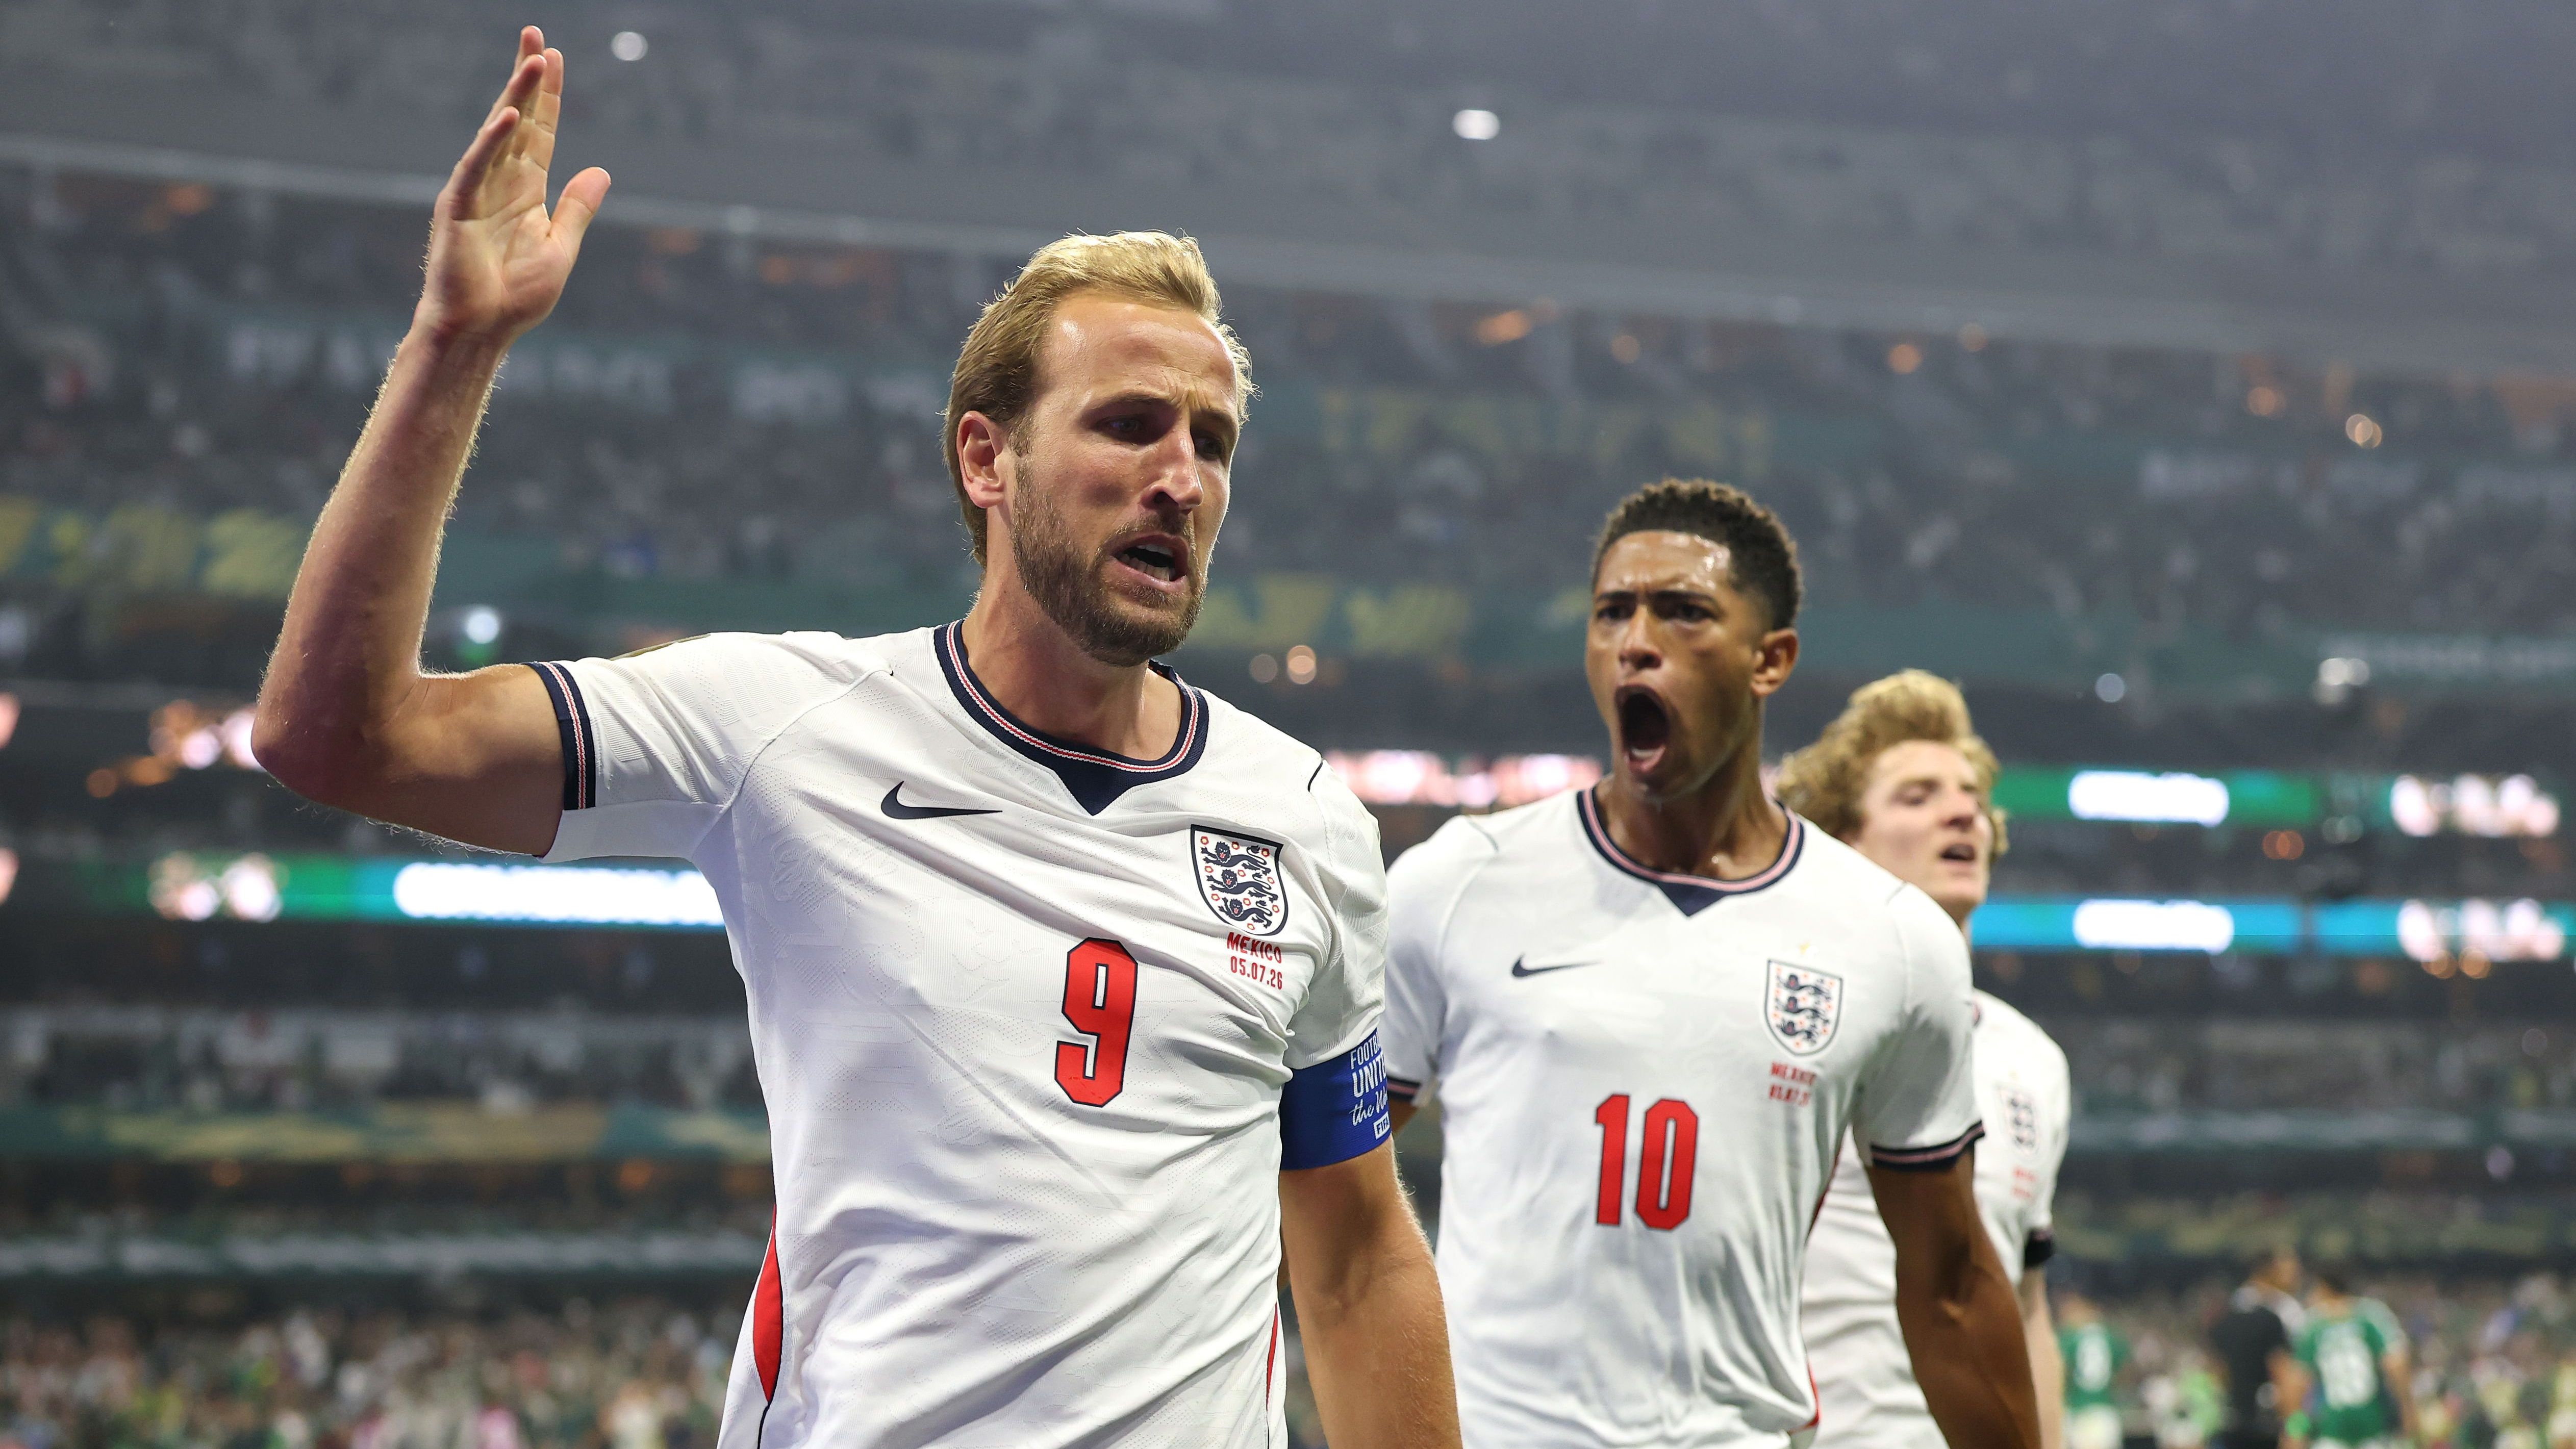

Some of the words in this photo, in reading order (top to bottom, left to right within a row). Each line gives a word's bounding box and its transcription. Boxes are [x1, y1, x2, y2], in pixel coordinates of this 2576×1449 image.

[1227, 931, 1282, 963] MEXICO
[1230, 956, 1282, 990] 05.07.26
[1054, 937, 1138, 1108] 9
[1350, 1031, 1379, 1070] FOOTB
[1349, 1099, 1374, 1126] the
[1594, 1094, 1699, 1231] 10
